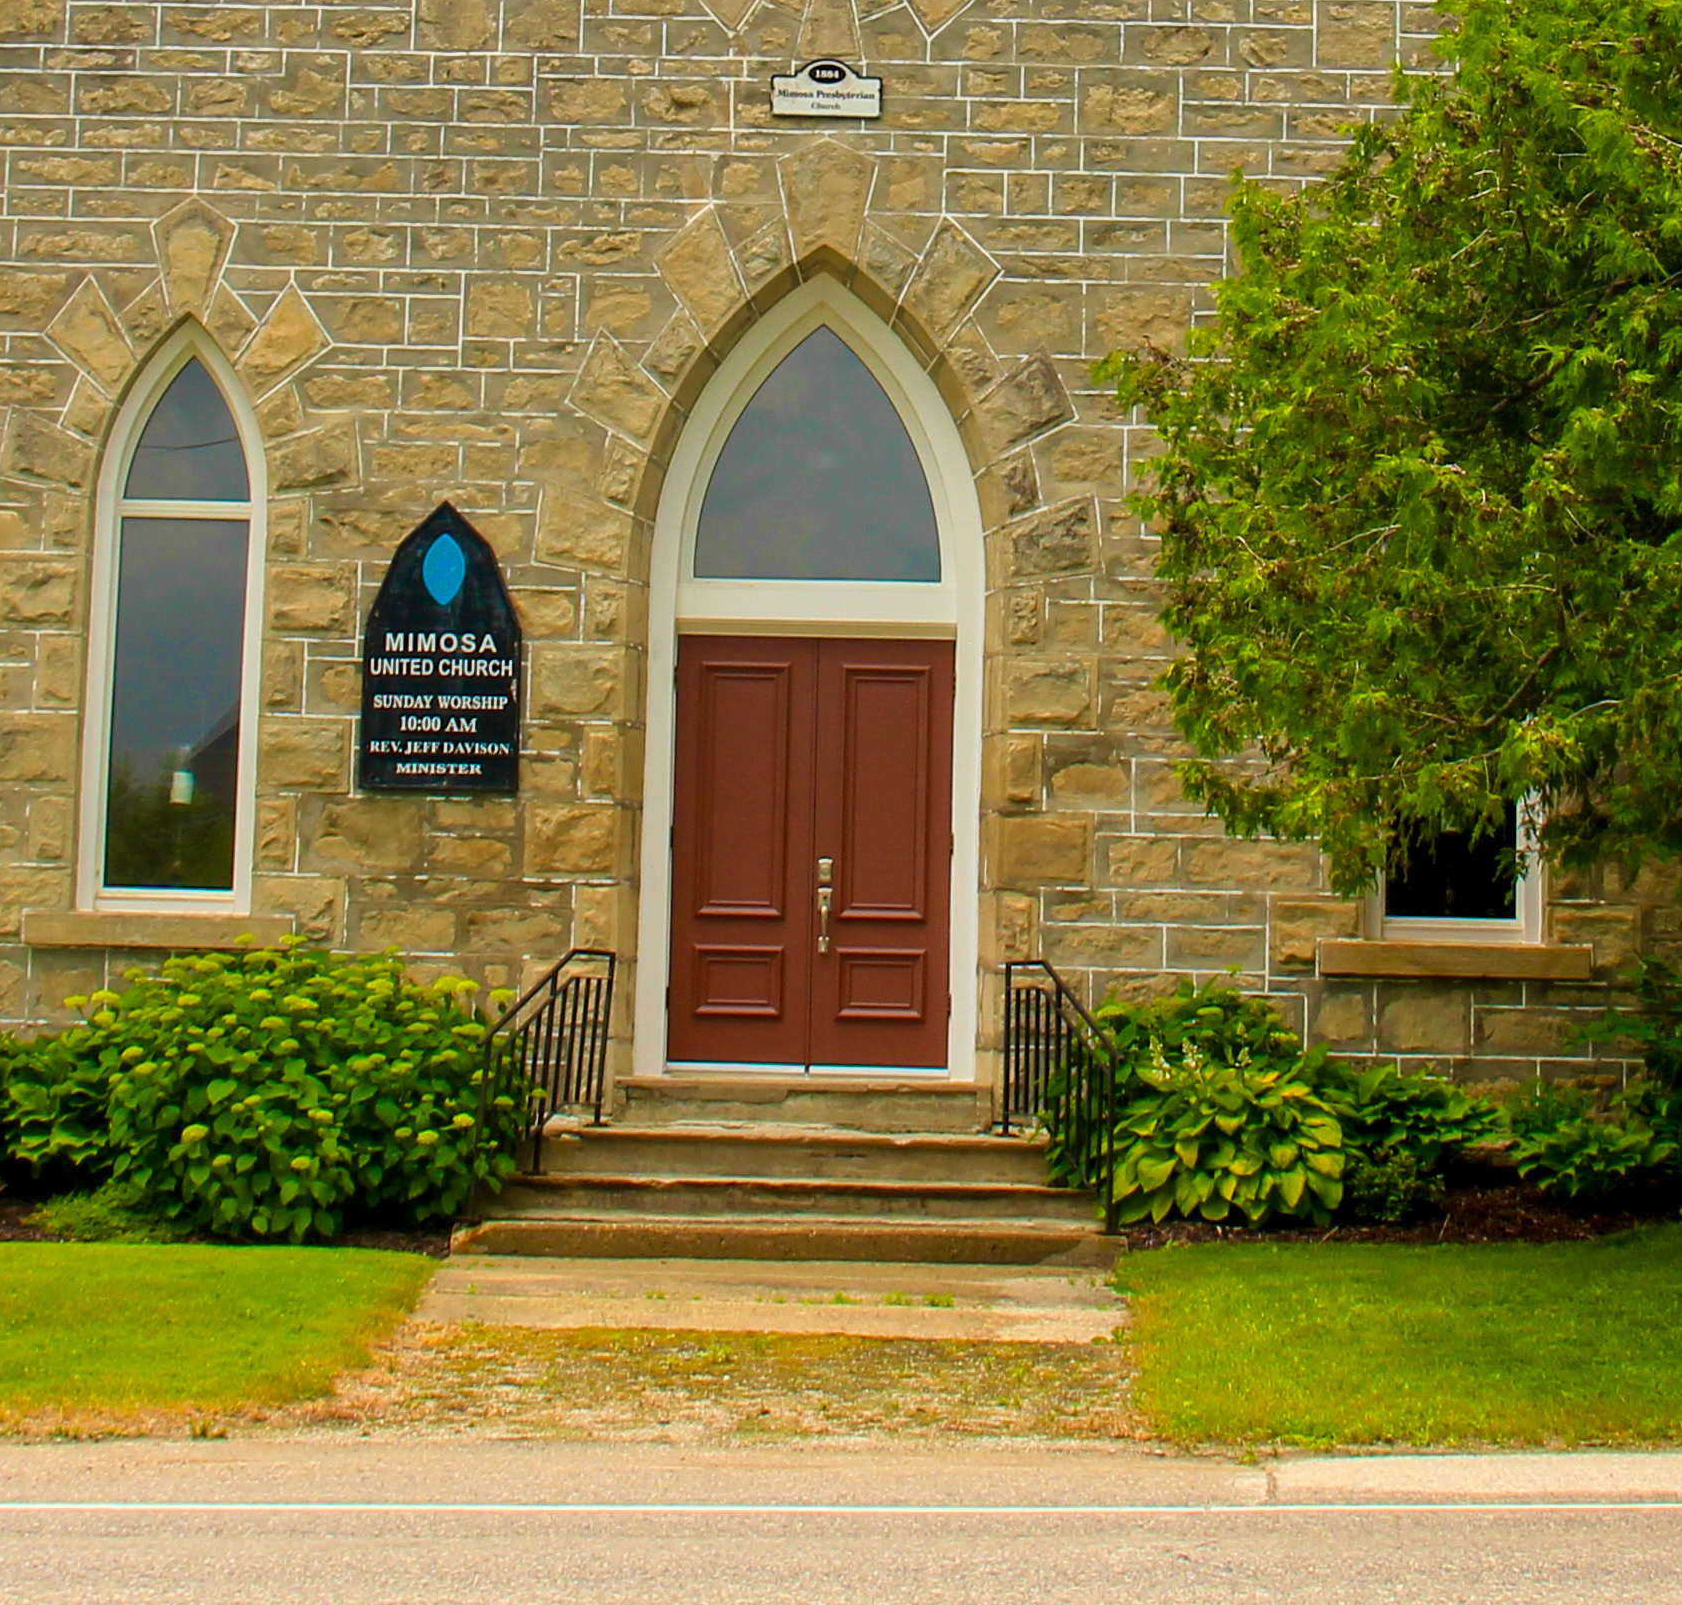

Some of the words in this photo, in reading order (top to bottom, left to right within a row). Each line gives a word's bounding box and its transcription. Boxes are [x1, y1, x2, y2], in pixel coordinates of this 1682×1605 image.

[777, 89, 814, 99] Mimosa
[816, 90, 875, 101] Presbyterian
[385, 632, 498, 654] MIMOSA
[370, 657, 434, 676] UNITED
[438, 659, 513, 677] CHURCH
[373, 694, 434, 709] SUNDAY
[437, 695, 508, 710] WORSHIP
[400, 715, 440, 732] 10:00
[445, 717, 478, 733] AM
[369, 740, 402, 753] REV.
[404, 741, 441, 754] JEFF
[443, 742, 510, 755] DAVISON
[395, 763, 483, 775] MINISTER
